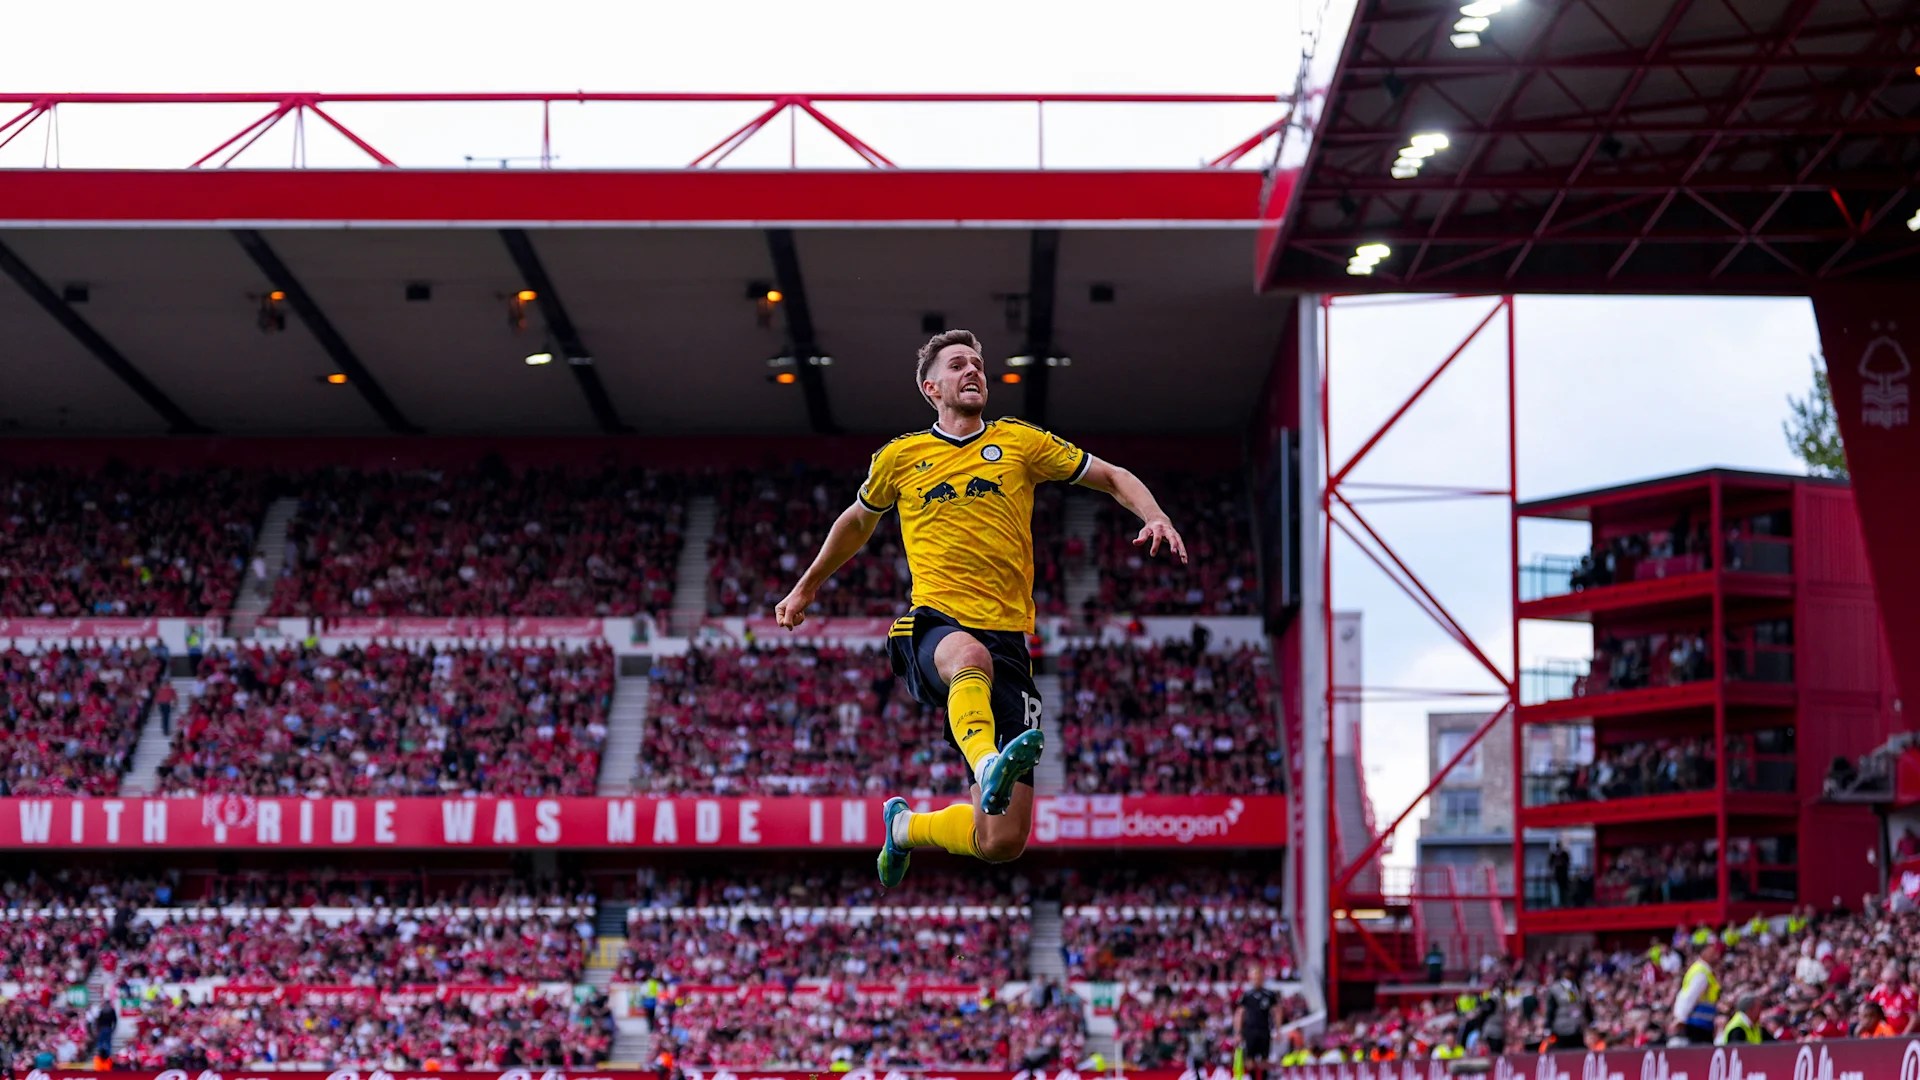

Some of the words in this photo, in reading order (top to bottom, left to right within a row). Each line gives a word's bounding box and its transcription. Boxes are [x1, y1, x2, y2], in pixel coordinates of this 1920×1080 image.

[19, 800, 168, 843] WITH
[442, 800, 562, 843] WAS
[608, 800, 761, 843] MADE
[809, 800, 867, 843] IN
